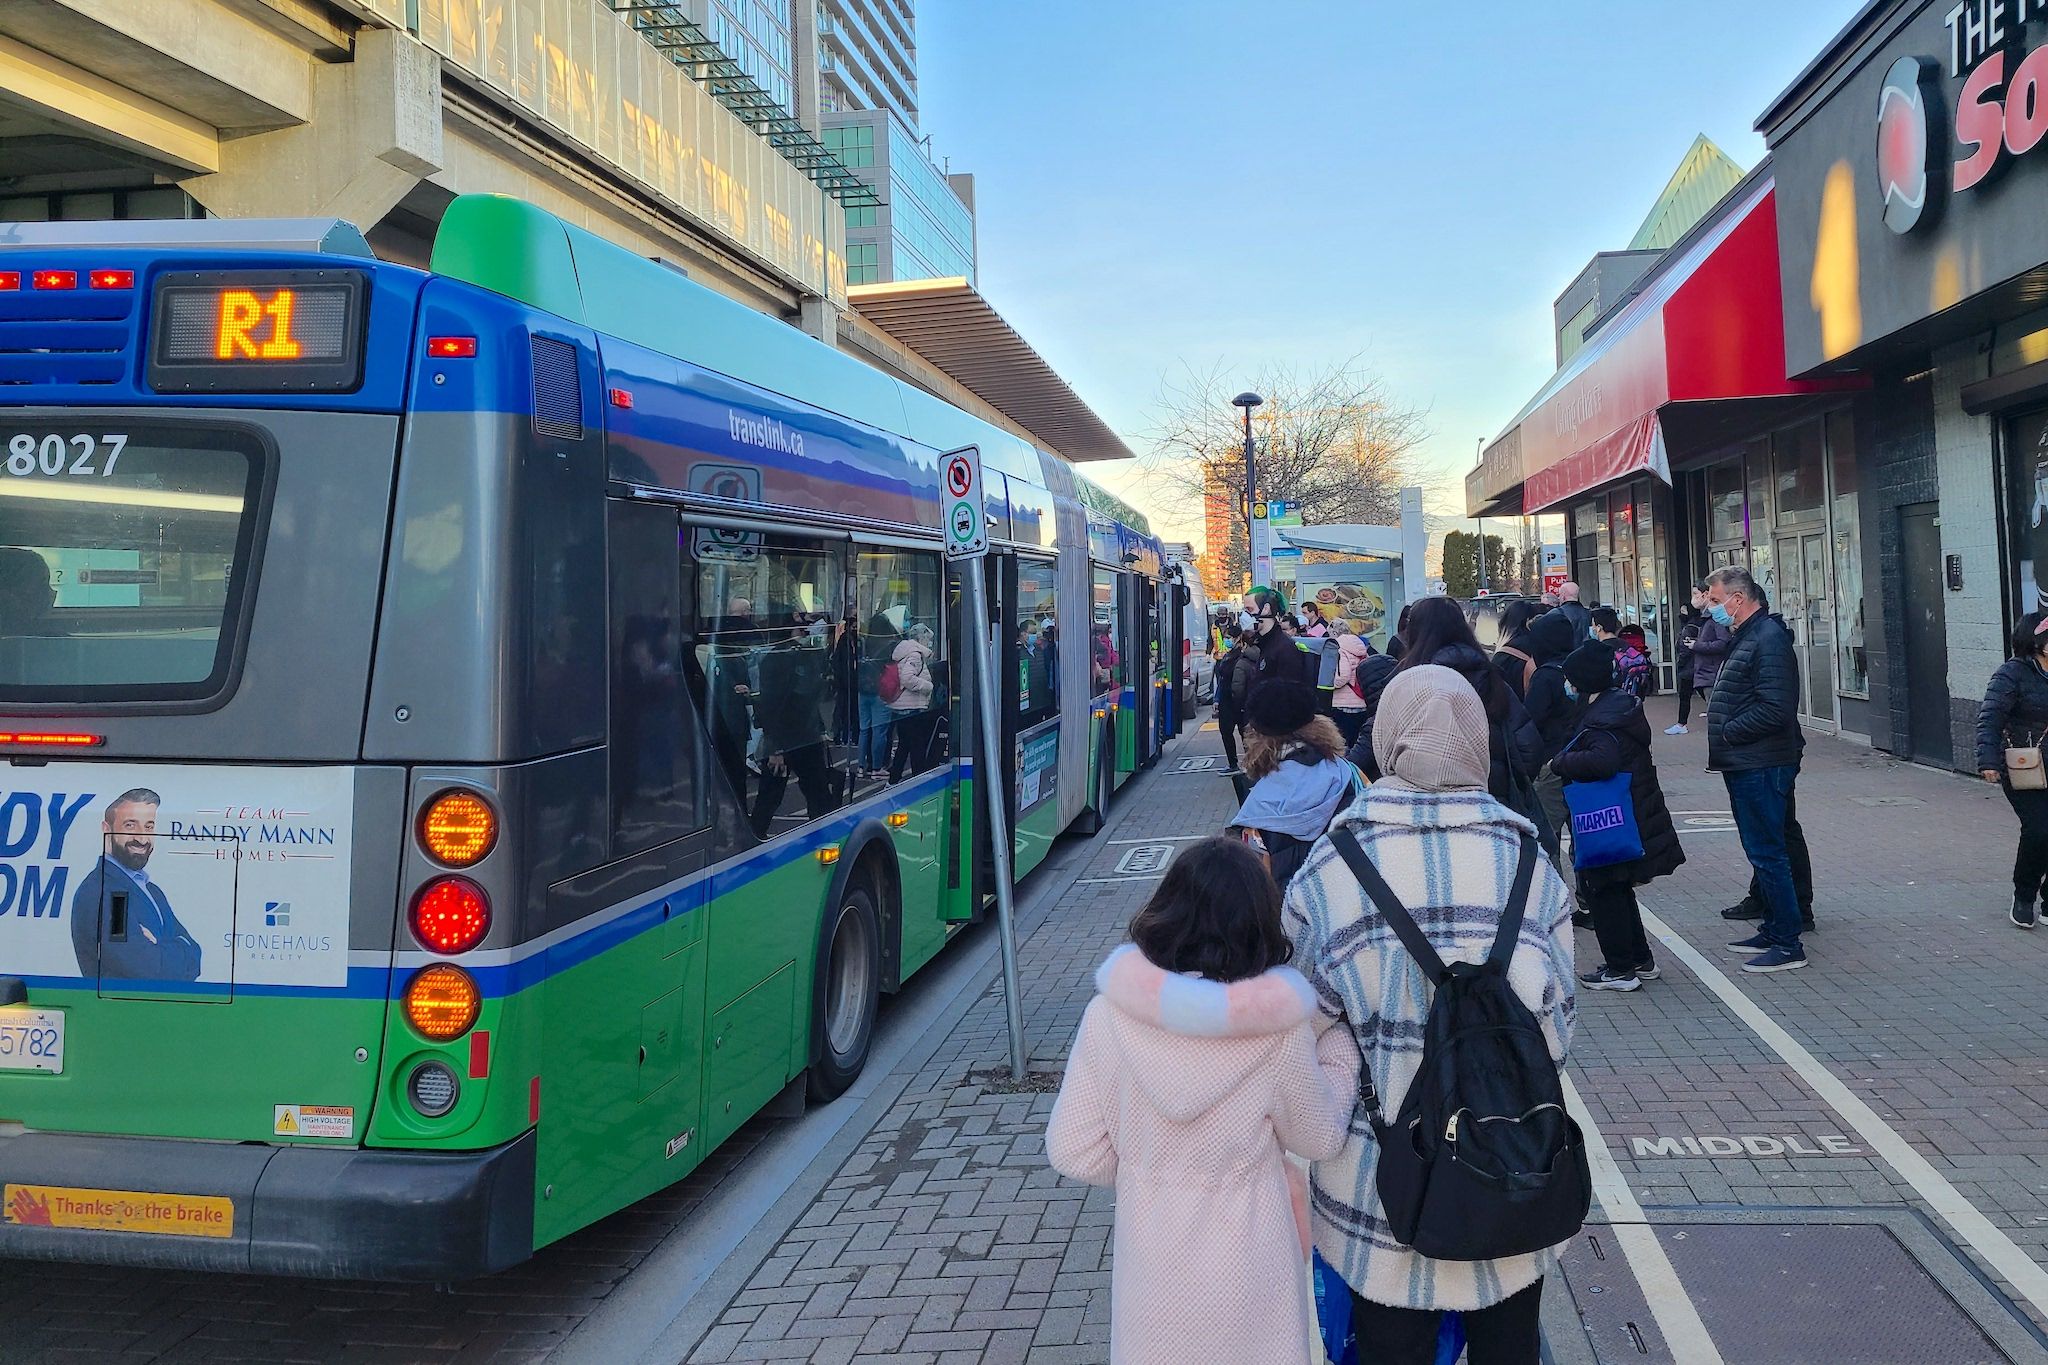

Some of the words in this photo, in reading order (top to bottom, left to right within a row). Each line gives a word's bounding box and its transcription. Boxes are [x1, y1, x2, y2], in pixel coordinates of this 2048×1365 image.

[1945, 0, 2005, 78] THE
[1953, 43, 2048, 193] SO
[217, 289, 300, 359] R1
[728, 408, 805, 457] translink.ca
[7, 433, 129, 477] 8027
[223, 805, 286, 820] TEAM
[1576, 807, 1622, 832] MARVEL
[0, 791, 97, 860] DY
[170, 821, 253, 843] RANDY
[259, 823, 336, 845] MANN
[215, 849, 288, 862] HOMES
[223, 933, 331, 951] STONEHAUS
[251, 952, 303, 961] REALTY
[0, 1026, 58, 1057] 5782
[301, 1116, 319, 1124] HIGH
[320, 1117, 352, 1125] VOLTAGE
[315, 1107, 349, 1115] WARNING
[1632, 1136, 1861, 1156] MIDDLE
[56, 1197, 113, 1216] Thanks
[145, 1205, 171, 1219] the
[176, 1205, 223, 1223] brake
